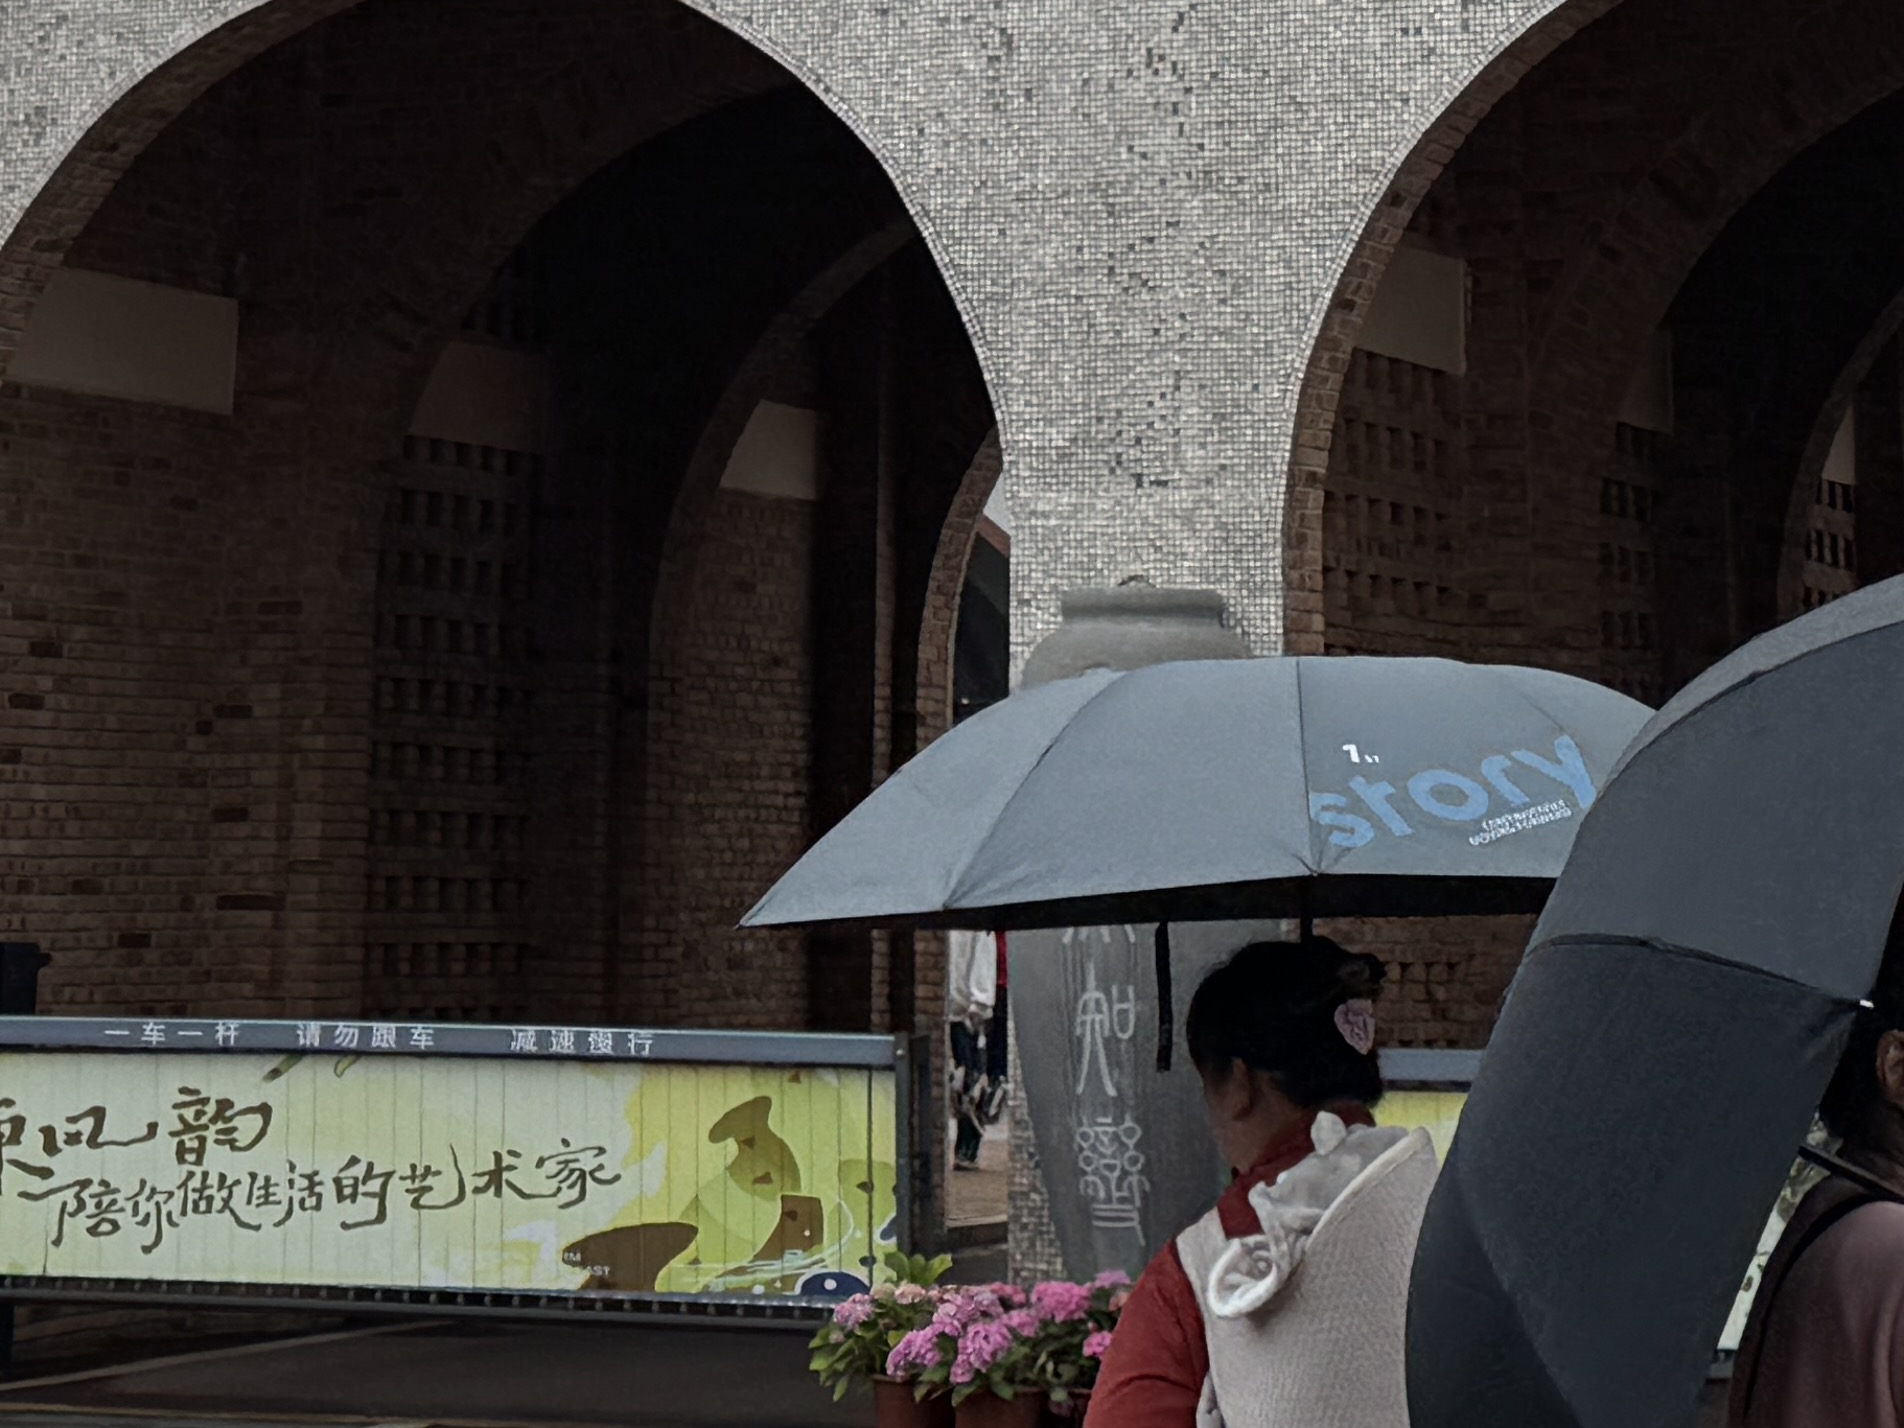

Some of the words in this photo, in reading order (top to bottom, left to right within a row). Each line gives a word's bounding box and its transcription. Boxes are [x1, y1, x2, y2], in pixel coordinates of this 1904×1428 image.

[104, 1020, 240, 1046] 一车一杆
[297, 1022, 436, 1050] 请勿跟车
[510, 1027, 653, 1056] 减速慢行
[18, 1137, 622, 1254] 陪你做生活的艺术家
